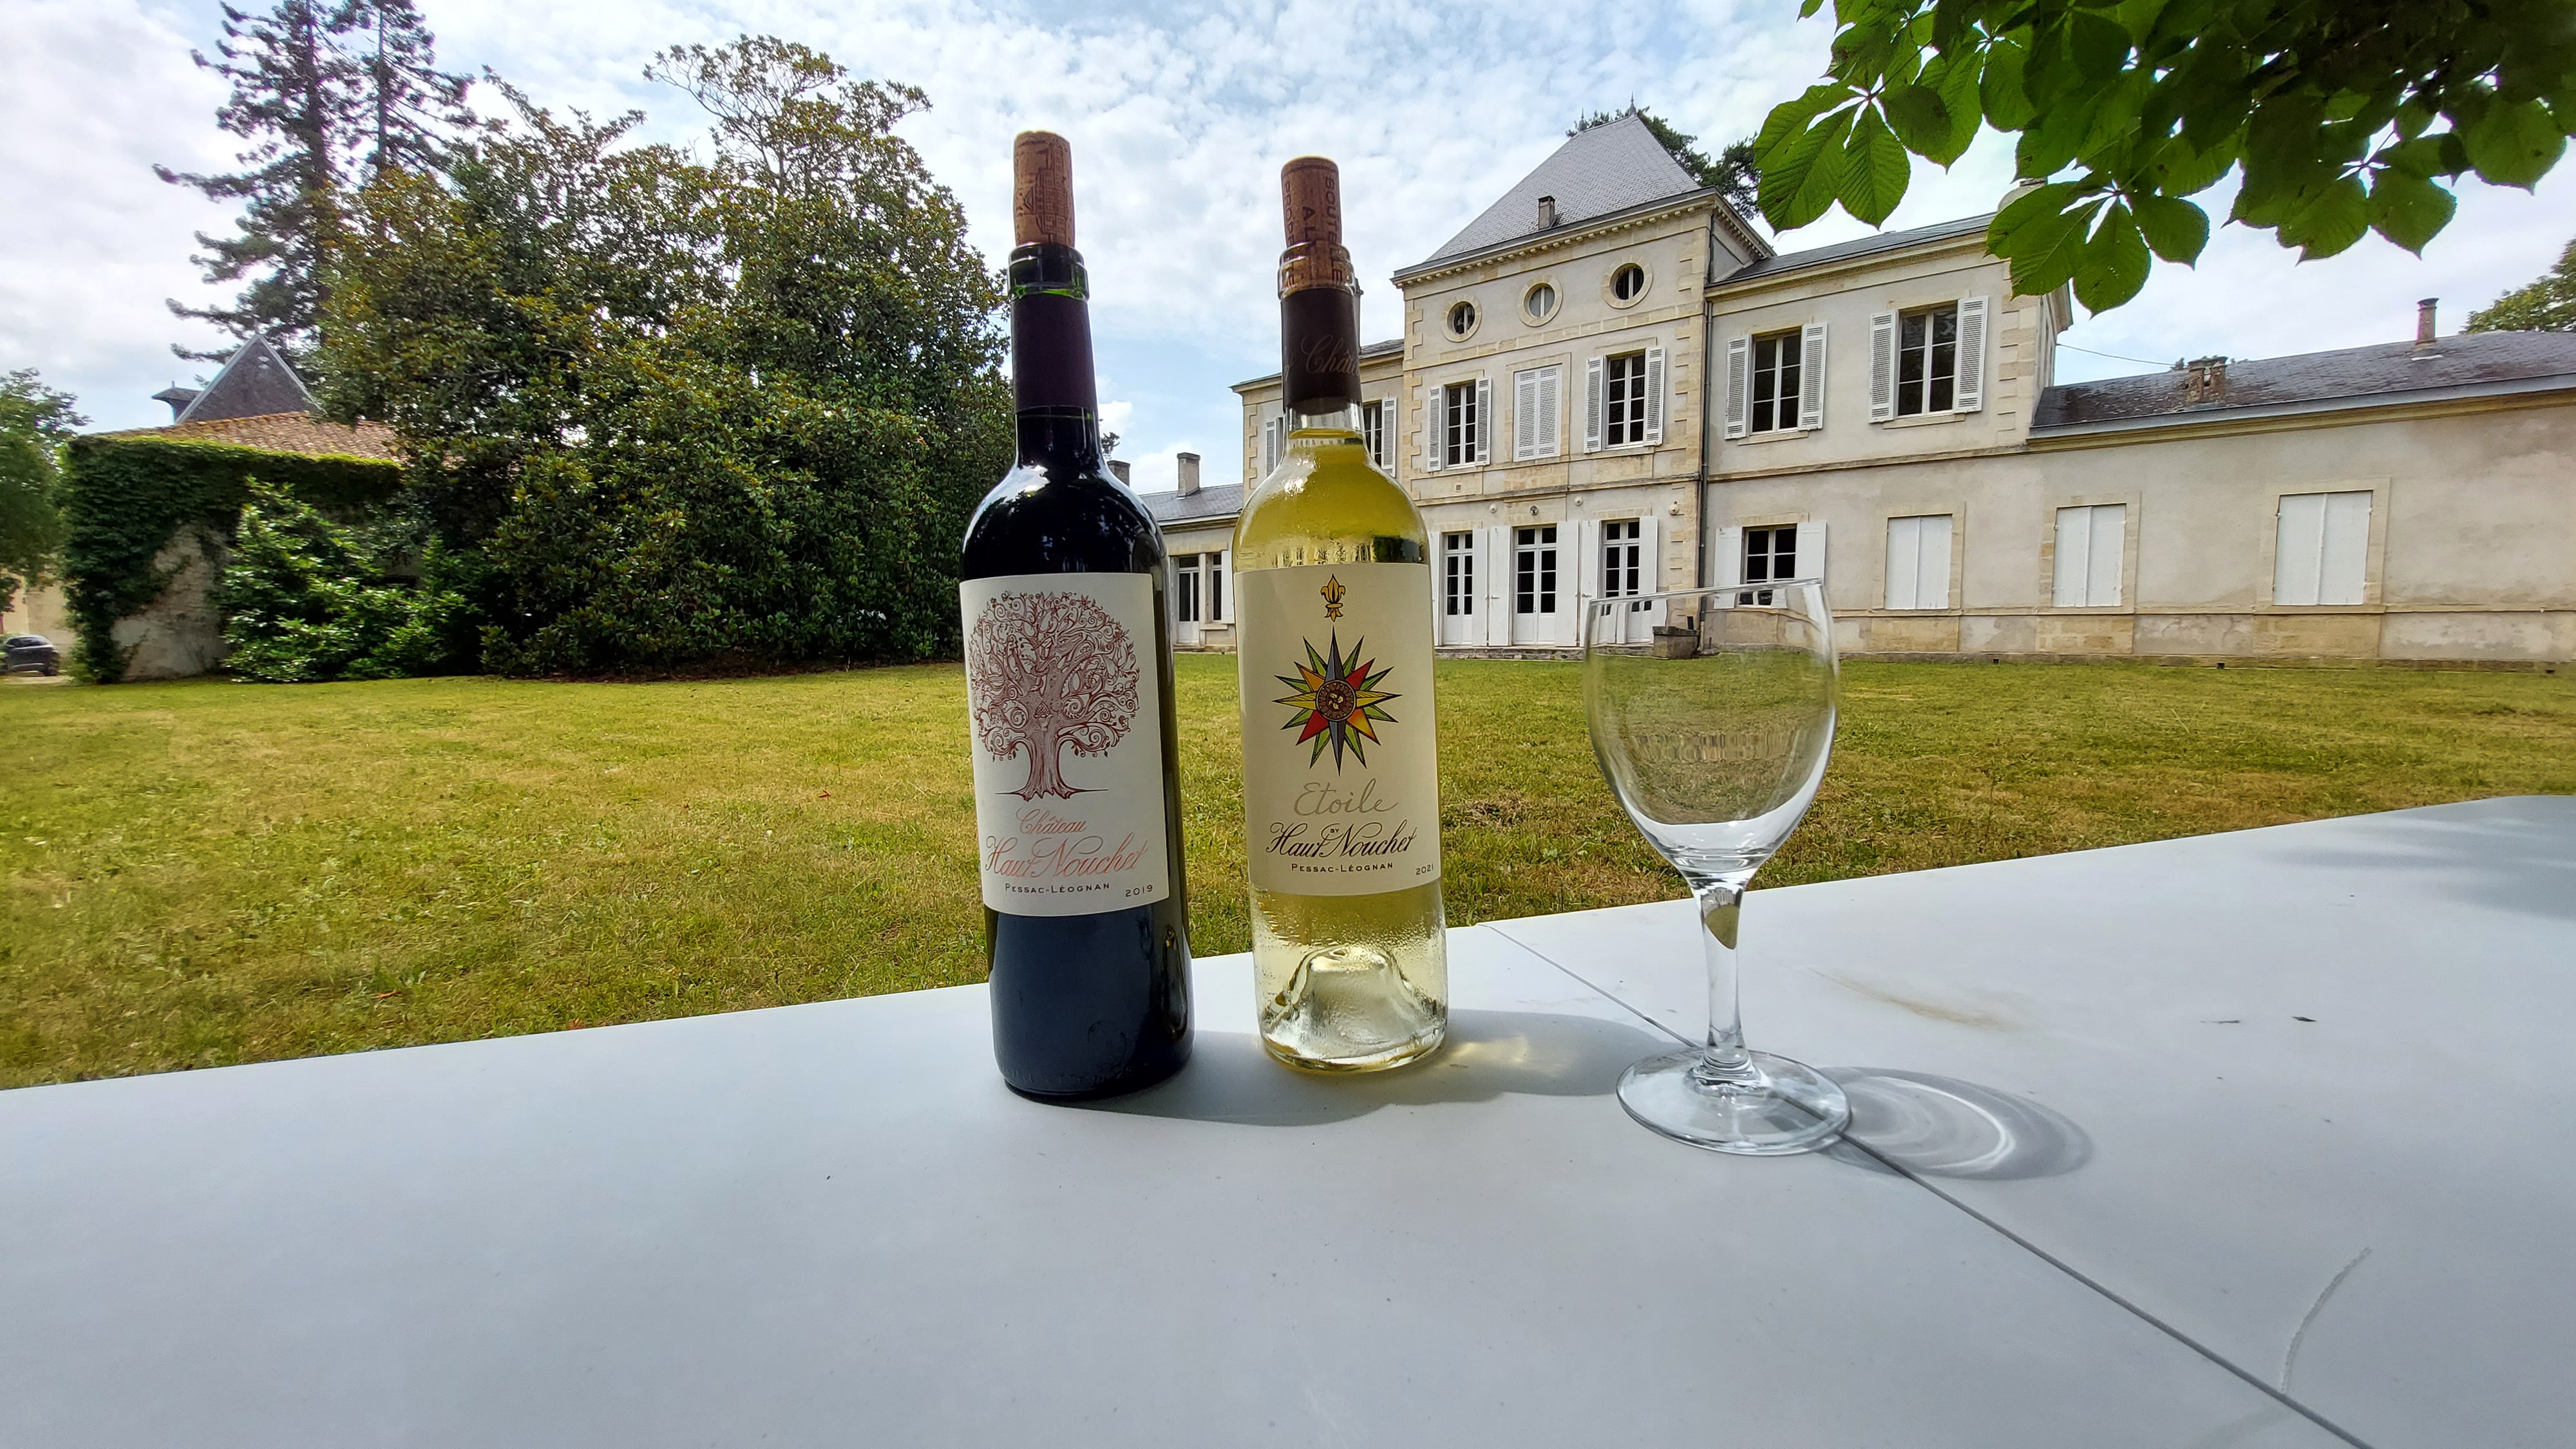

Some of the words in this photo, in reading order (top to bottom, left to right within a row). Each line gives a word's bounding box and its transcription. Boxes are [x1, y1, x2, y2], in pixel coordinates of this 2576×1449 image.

[1294, 778, 1399, 816] Etoile
[1016, 806, 1087, 835] Château
[1266, 822, 1331, 857] Haut
[1319, 819, 1417, 857] Nouchet
[985, 836, 1041, 878] Haut
[1028, 833, 1148, 877] Nouchet
[1416, 864, 1434, 876] 2021
[1125, 884, 1153, 898] 2019
